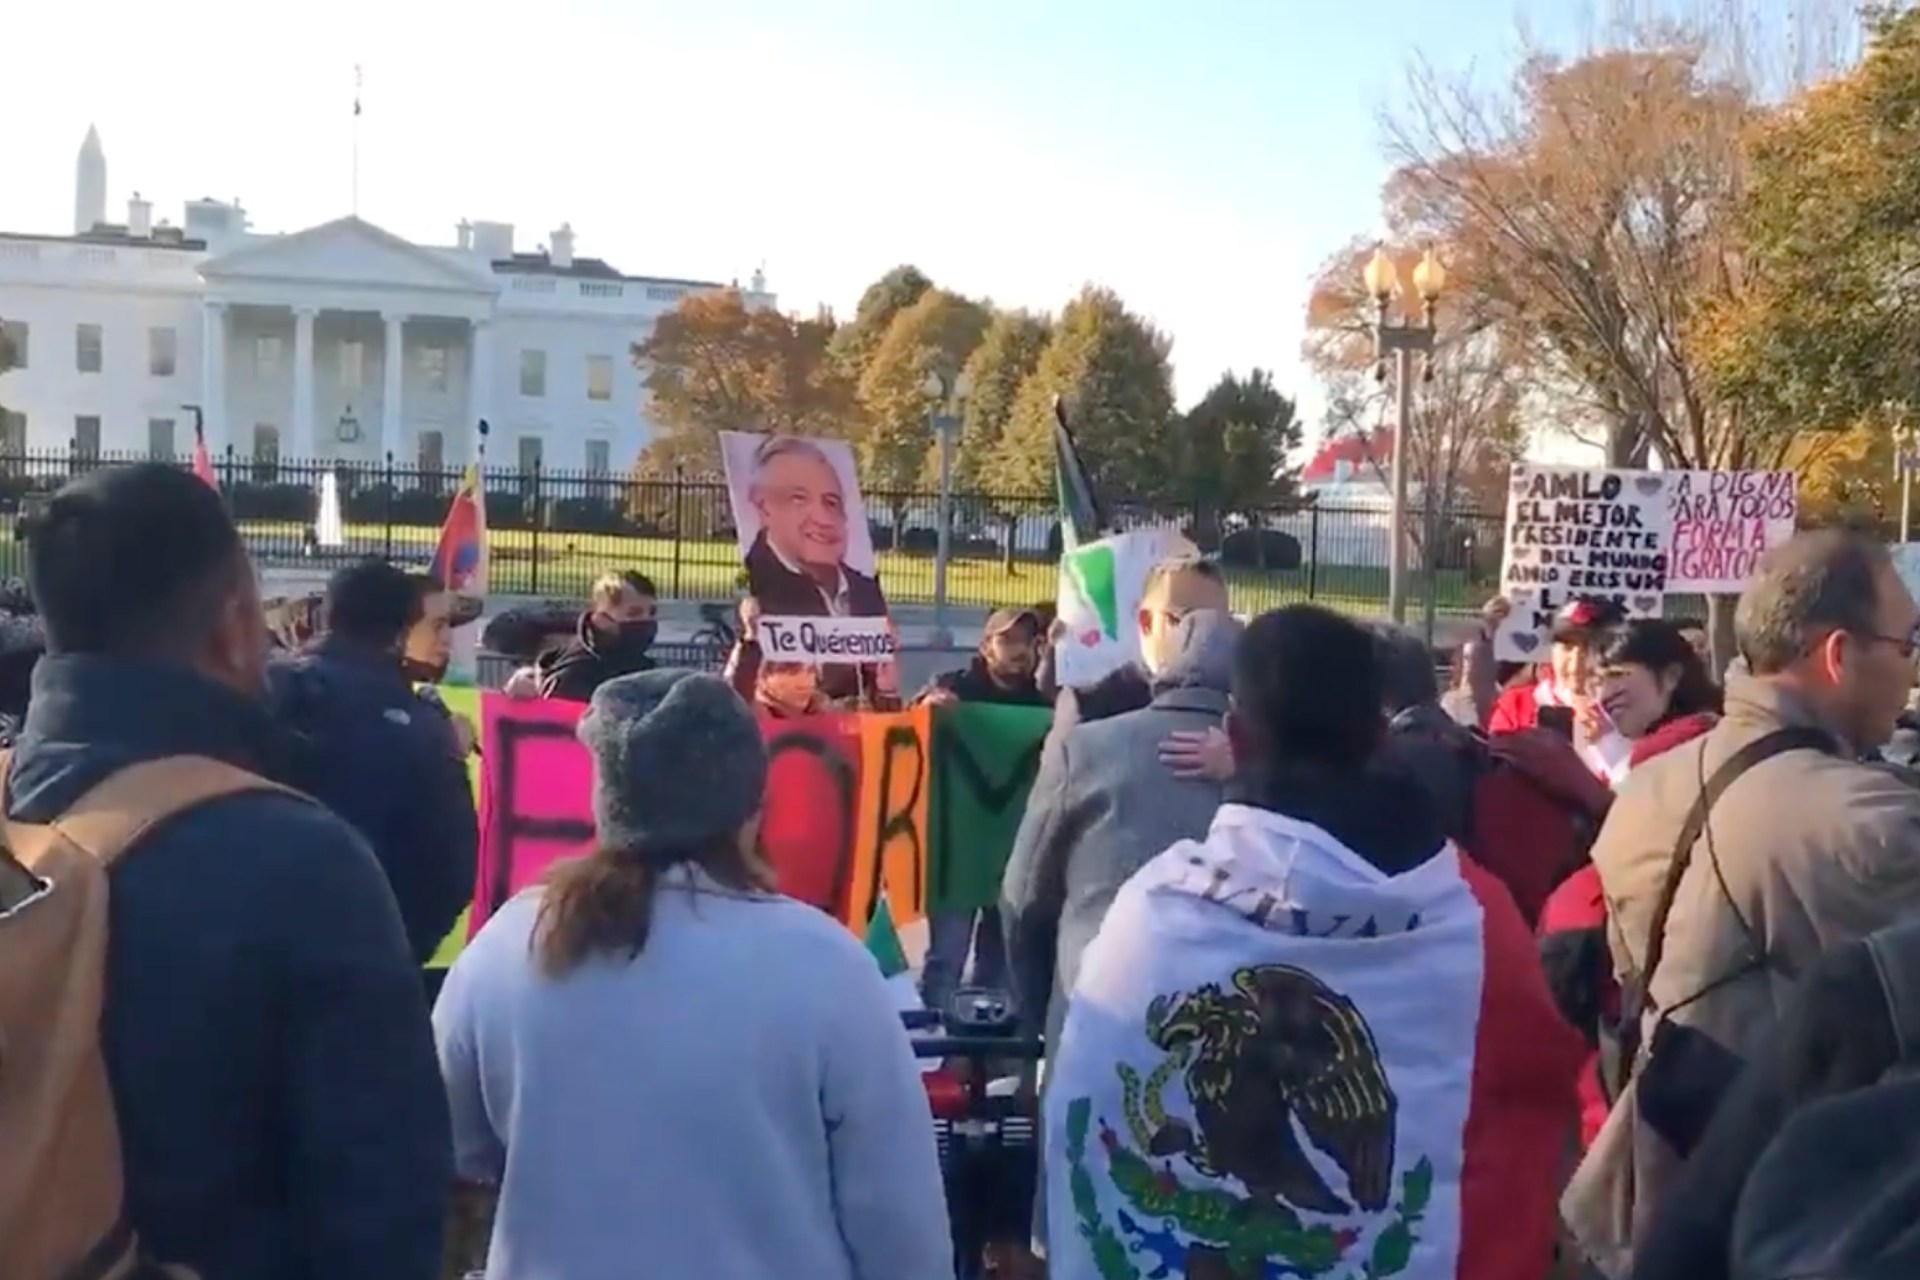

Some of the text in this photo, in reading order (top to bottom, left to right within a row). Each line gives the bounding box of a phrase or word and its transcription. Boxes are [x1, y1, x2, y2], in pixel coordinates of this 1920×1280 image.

[1529, 473, 1621, 500] AMLO
[1710, 471, 1794, 499] DIGNA
[1517, 502, 1643, 529] EL MEJOR
[1728, 494, 1794, 519] TODOS
[1511, 525, 1658, 549] PRESIDENTE
[1540, 549, 1668, 571] DEL MUNDO
[761, 621, 797, 652] Te
